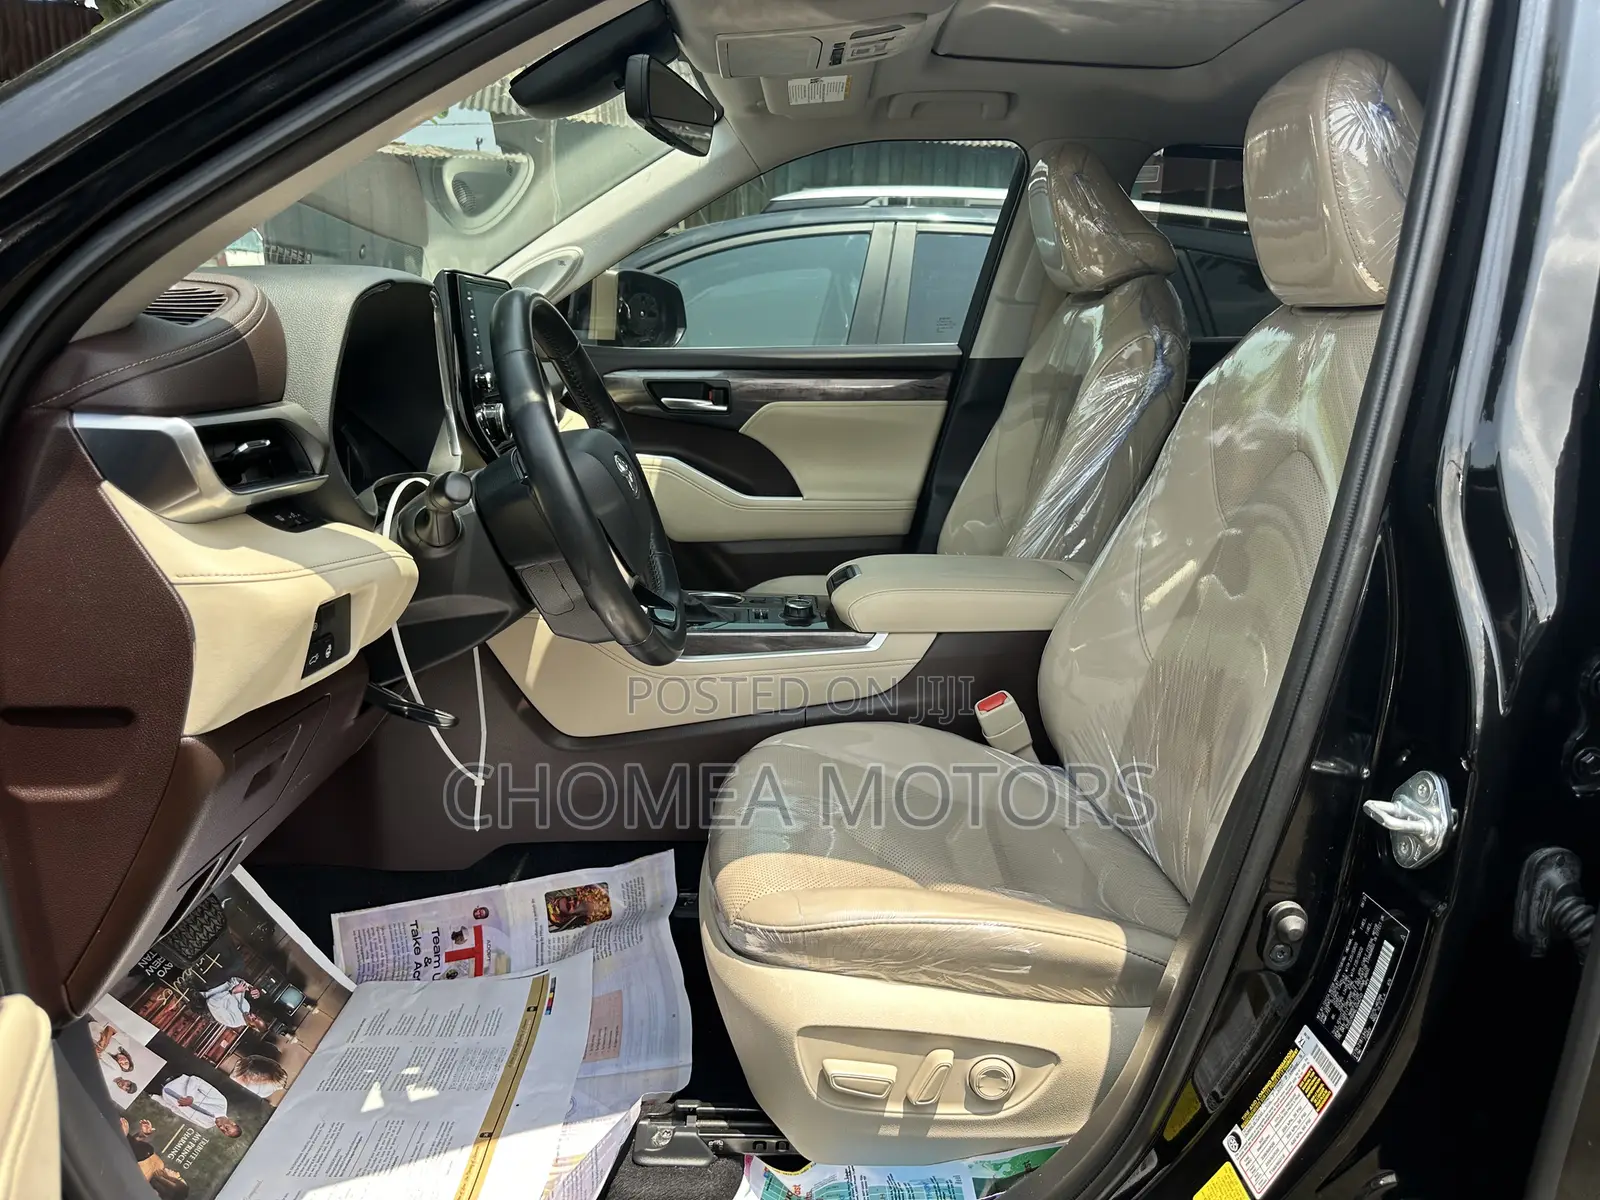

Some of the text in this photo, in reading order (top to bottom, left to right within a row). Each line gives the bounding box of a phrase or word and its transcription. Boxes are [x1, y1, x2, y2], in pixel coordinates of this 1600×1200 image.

[410, 919, 422, 956] Take
[431, 926, 441, 969] Team
[423, 956, 433, 968] &
[167, 1127, 195, 1160] CHARMING
[175, 1132, 202, 1165] MY PRINCE
[182, 1137, 210, 1170] TRIBUTE TO
